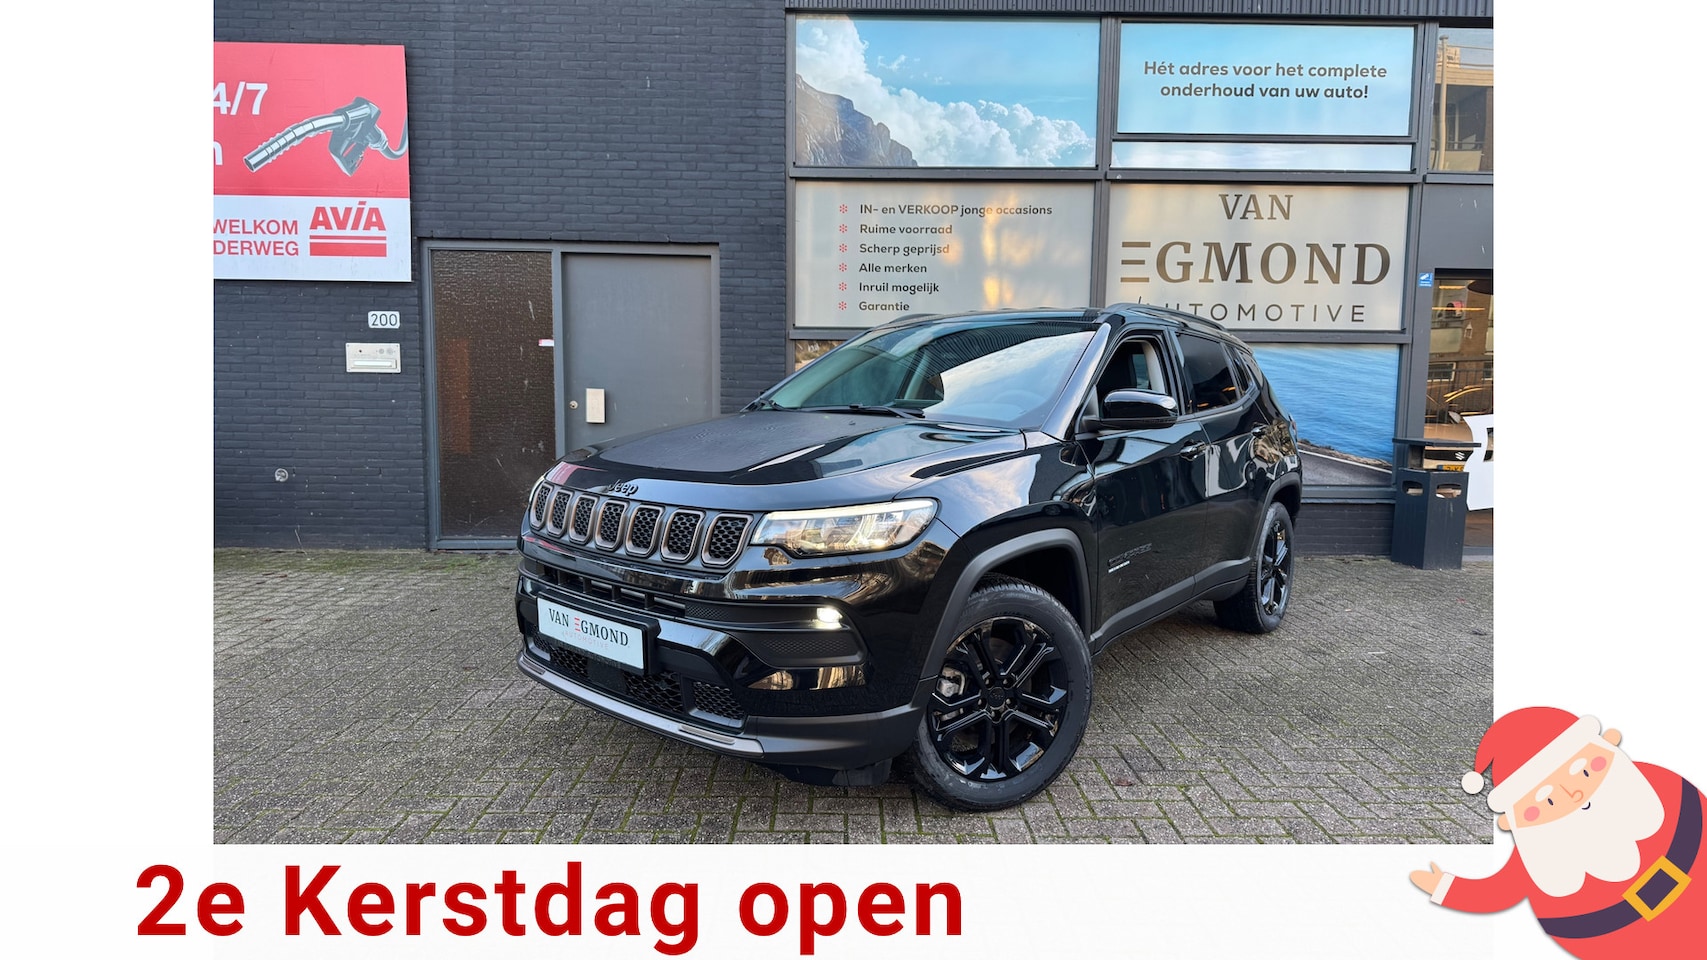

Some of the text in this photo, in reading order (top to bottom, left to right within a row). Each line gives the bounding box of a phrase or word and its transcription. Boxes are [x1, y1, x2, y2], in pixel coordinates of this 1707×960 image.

[1143, 60, 1387, 81] Hét adres voor het complete
[1160, 83, 1369, 99] onderhoud van uw auto!
[859, 204, 1053, 219] IN- en VERKOOP jonge occasions
[1218, 193, 1294, 221] VAN
[213, 219, 298, 235] WELKOM
[860, 223, 953, 235] Ruime voorraad
[859, 243, 950, 256] Scherp geprijsd
[859, 262, 928, 274] Alle merken
[1120, 241, 1391, 285] EGMOND
[859, 282, 940, 295] Inruil mogelijk
[858, 300, 911, 312] Garantie
[1146, 303, 1366, 323] TOMOTIVE
[370, 313, 398, 327] 200
[608, 479, 639, 497] Jeep
[548, 608, 630, 647] VAN EGMOND
